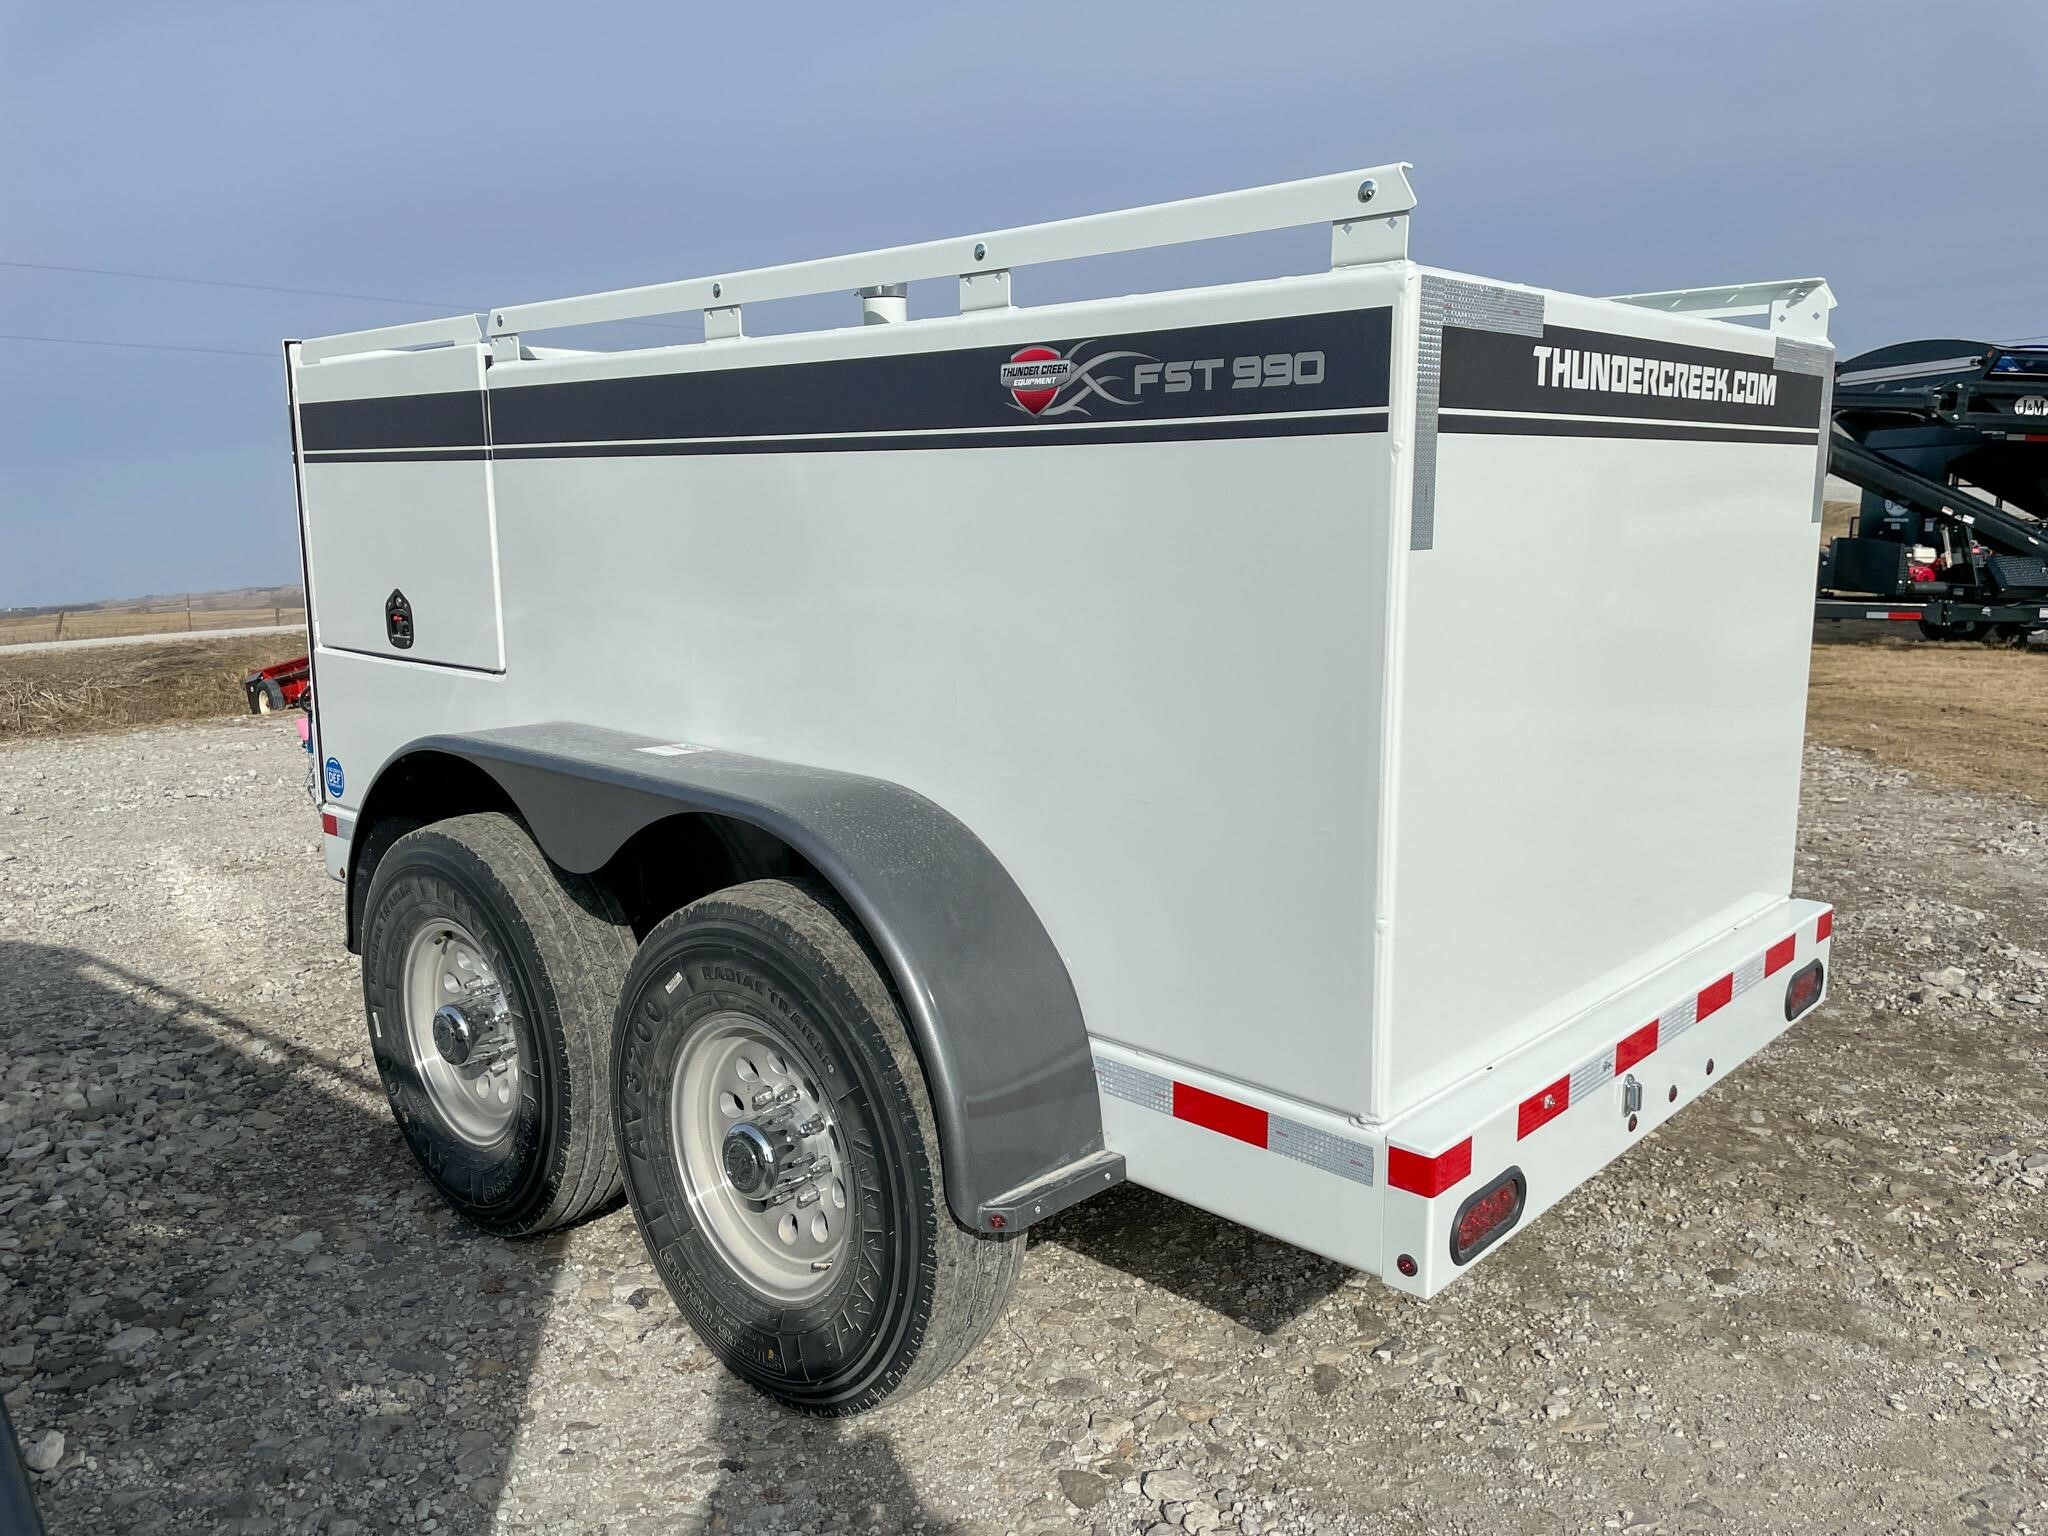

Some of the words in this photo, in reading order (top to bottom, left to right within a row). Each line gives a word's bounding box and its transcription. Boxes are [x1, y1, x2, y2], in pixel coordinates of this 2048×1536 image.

[1003, 366, 1040, 377] THUNDER
[1041, 363, 1069, 375] CREEK
[1013, 376, 1057, 387] EQUIPMENT
[1134, 358, 1225, 395] FST
[1232, 350, 1326, 389] 990
[1533, 345, 1777, 406] THUNDERCREEK.COM
[701, 966, 763, 996] RADIAL
[767, 987, 836, 1076] TRAILER
